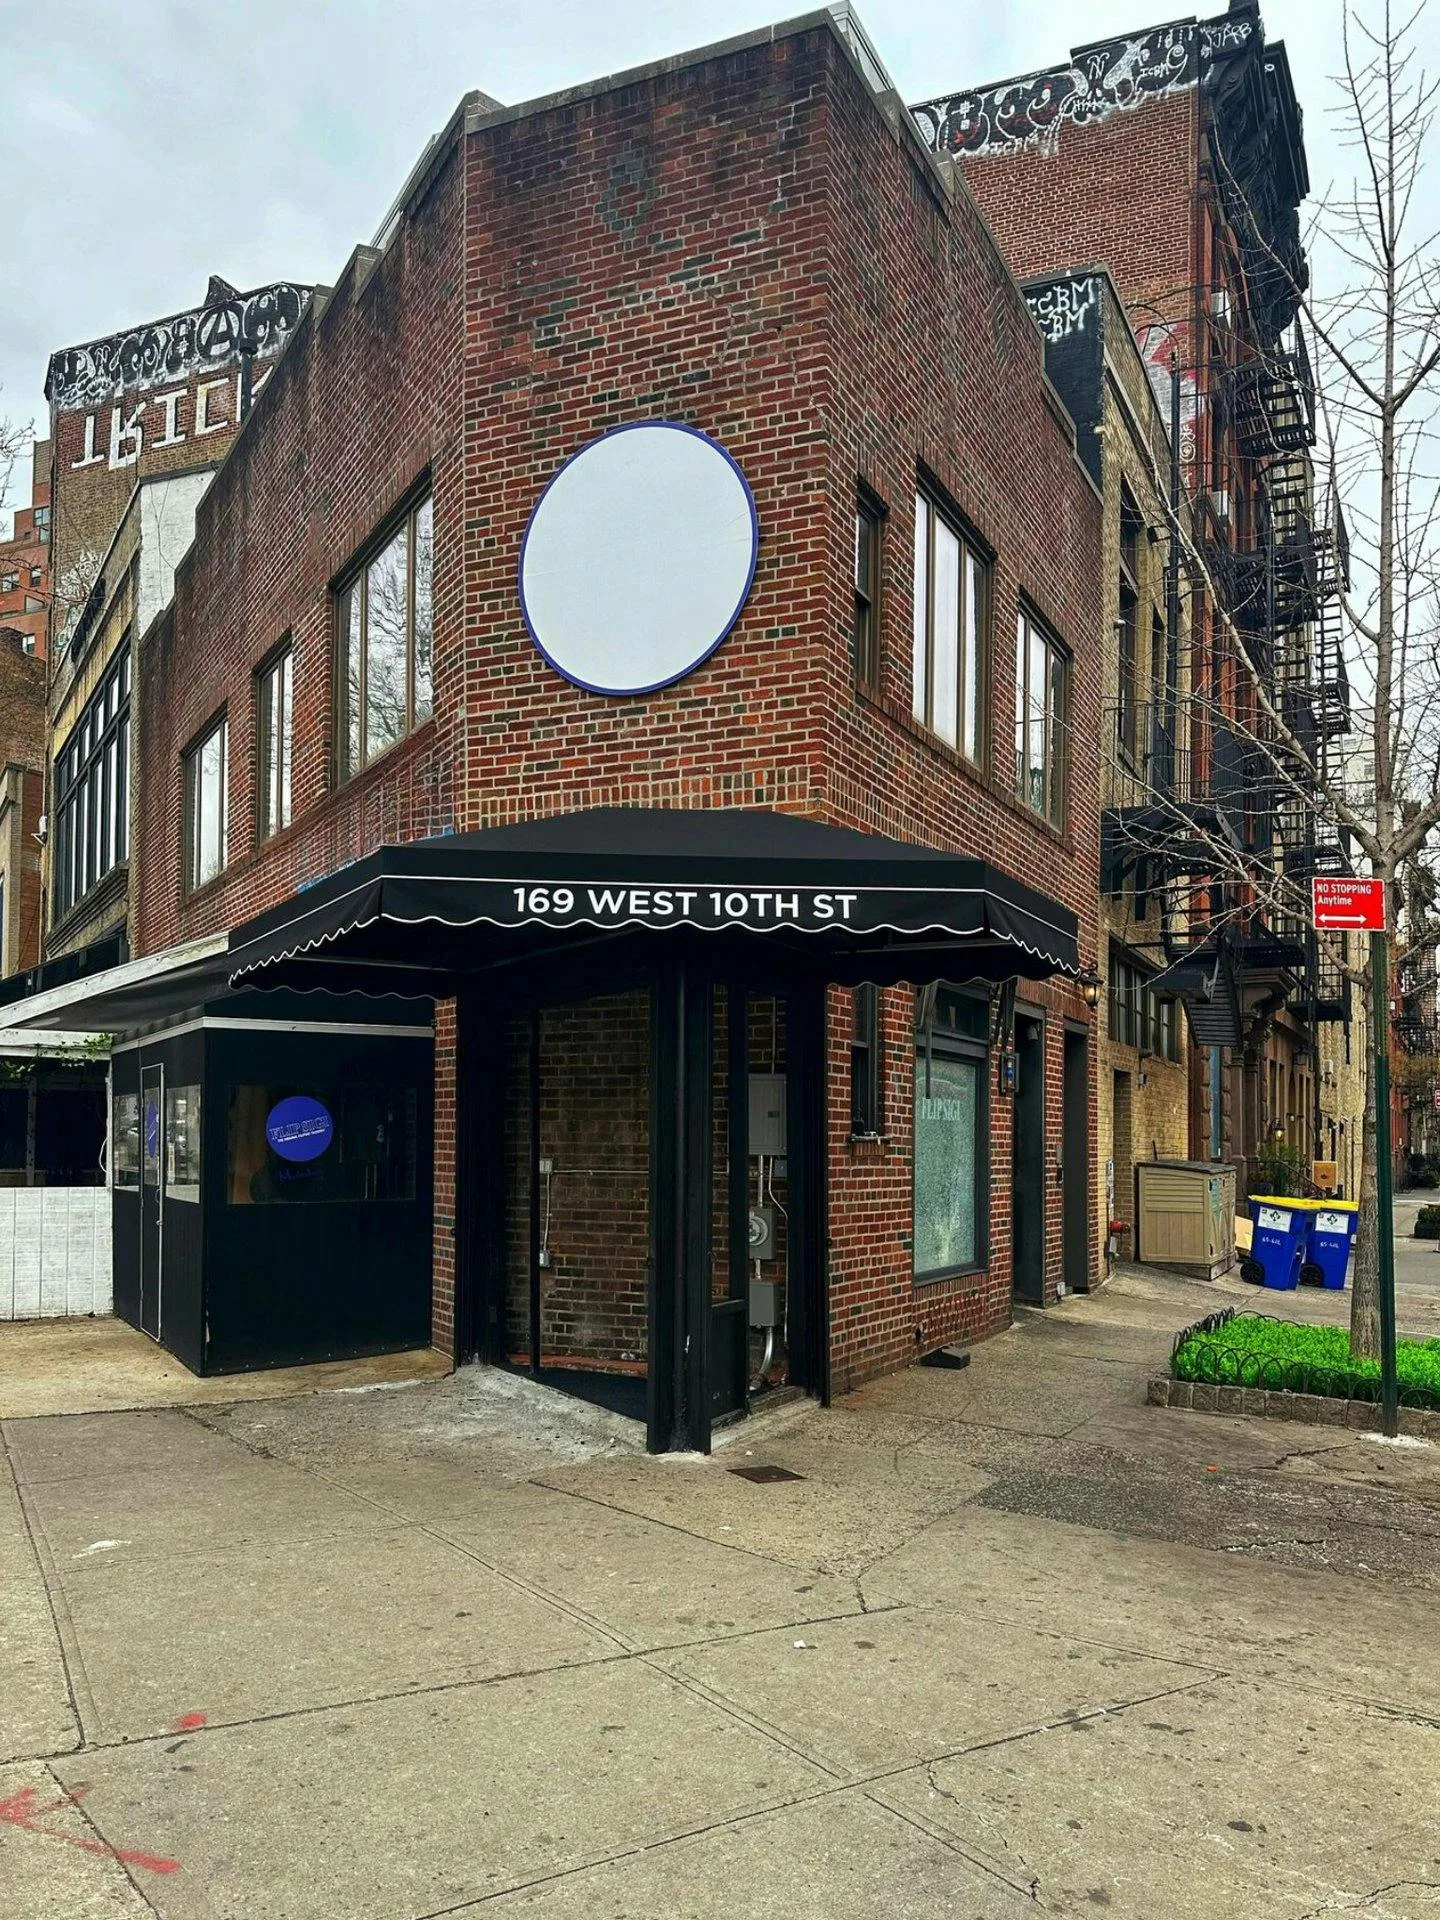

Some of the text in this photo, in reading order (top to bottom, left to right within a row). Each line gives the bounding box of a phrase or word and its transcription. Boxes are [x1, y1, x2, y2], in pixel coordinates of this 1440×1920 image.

[1316, 883, 1372, 894] NO STOPPING
[512, 887, 857, 919] 169 WEST 10TH ST
[1317, 895, 1353, 907] Anytime
